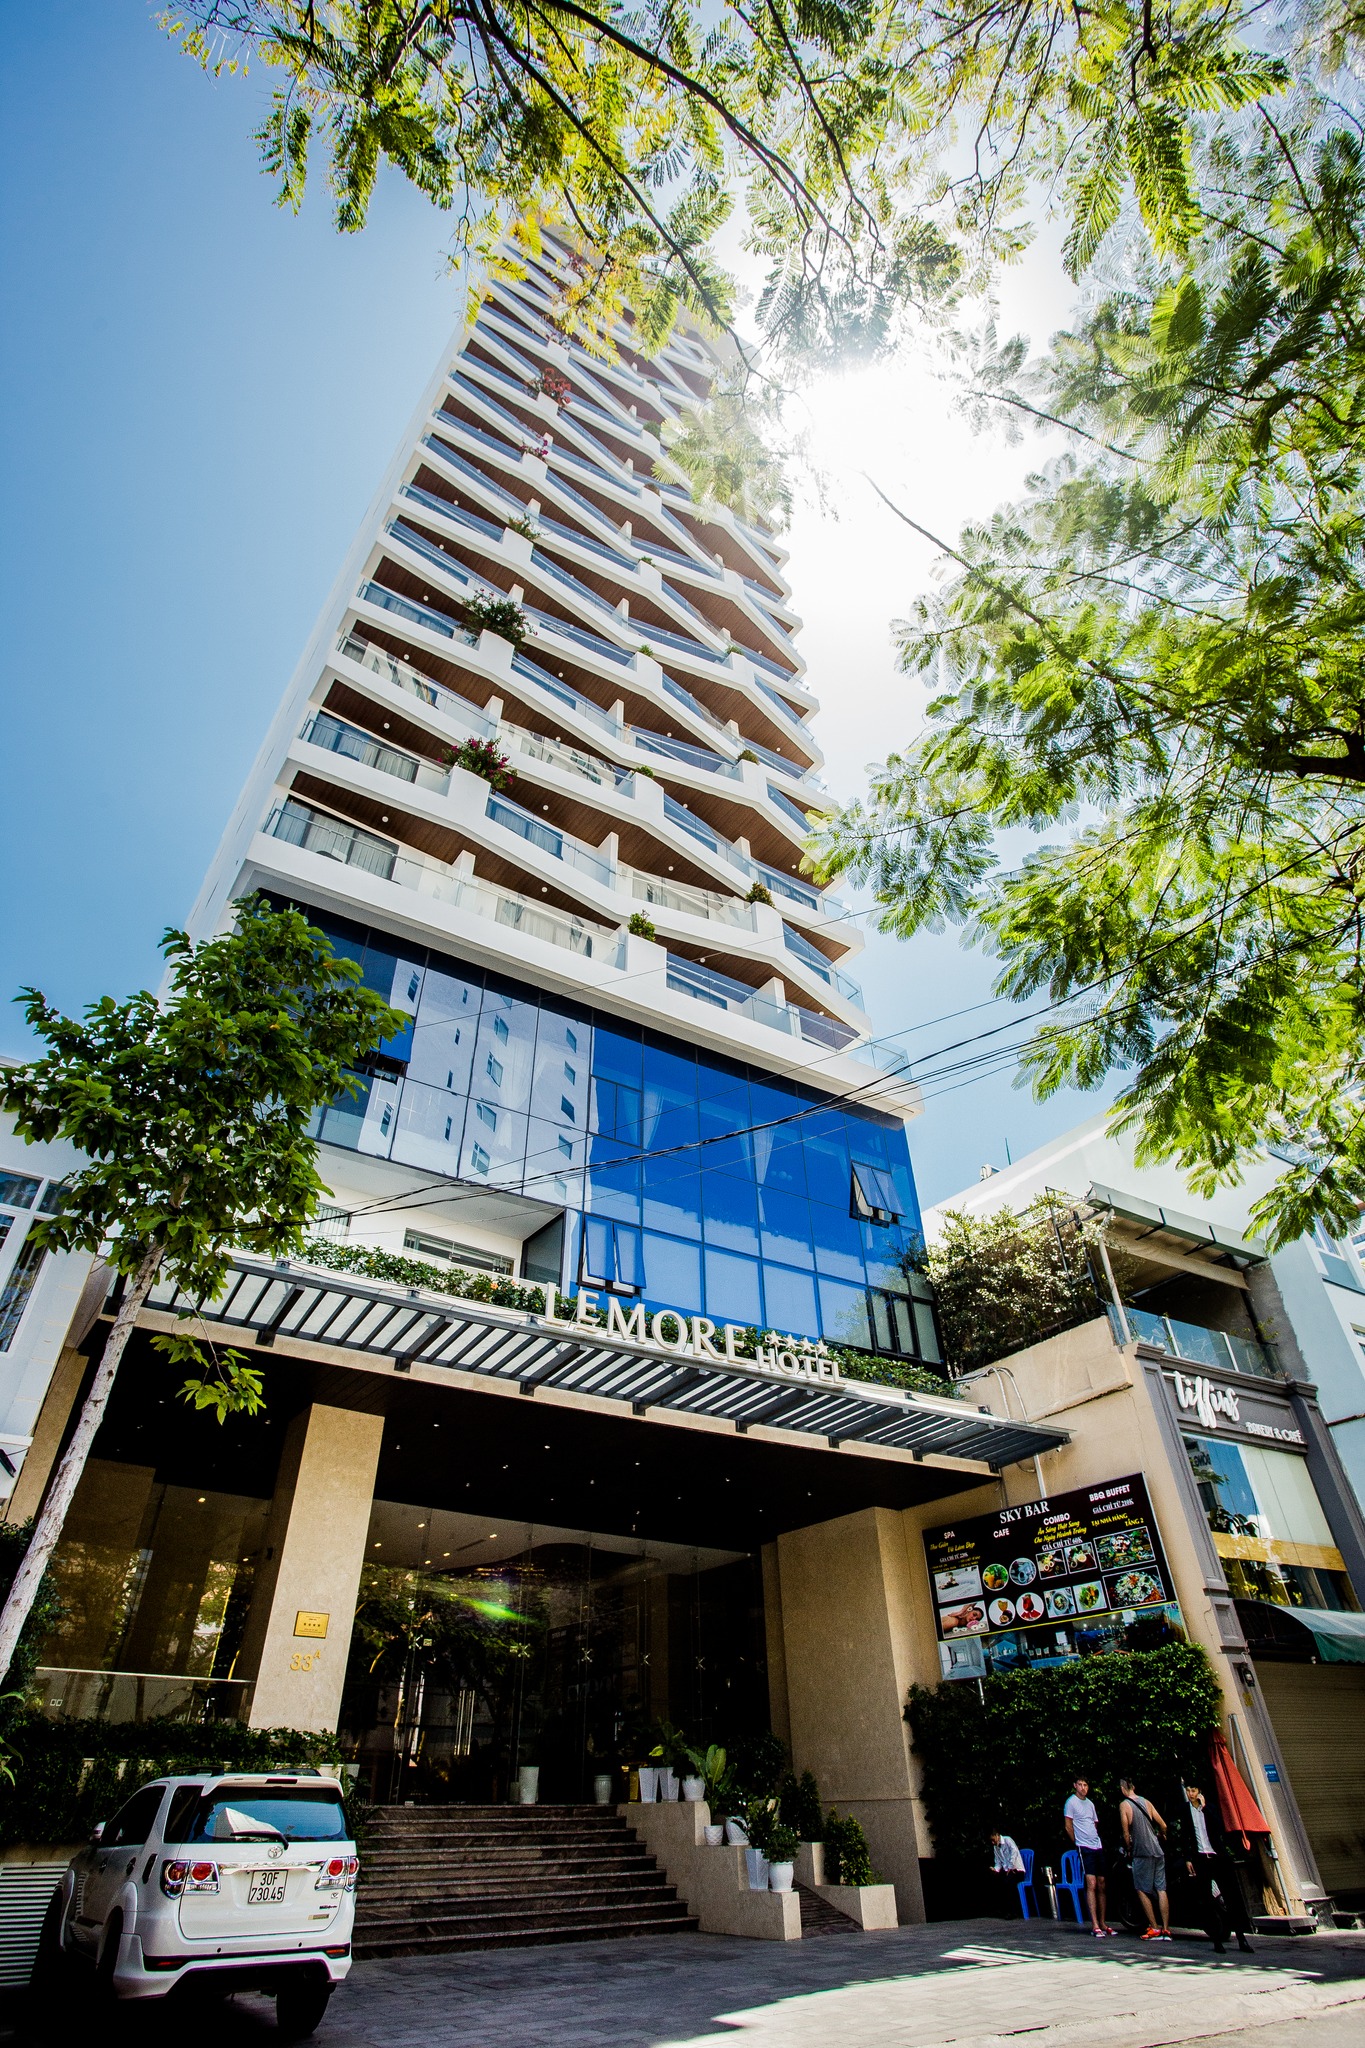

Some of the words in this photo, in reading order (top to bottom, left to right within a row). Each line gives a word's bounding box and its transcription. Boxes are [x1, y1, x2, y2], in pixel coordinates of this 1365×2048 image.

[544, 1281, 750, 1365] LEMORE
[755, 1345, 847, 1385] HOTEL
[1089, 1491, 1106, 1502] BBQ
[1105, 1484, 1130, 1498] BUFFET
[1000, 1507, 1022, 1524] SKY
[1024, 1501, 1050, 1517] BAR
[1043, 1512, 1070, 1525] COMBO
[944, 1531, 955, 1539] SPA
[993, 1528, 1010, 1538] CAFE
[260, 1872, 279, 1886] 30F
[250, 1887, 284, 1901] 730.45
